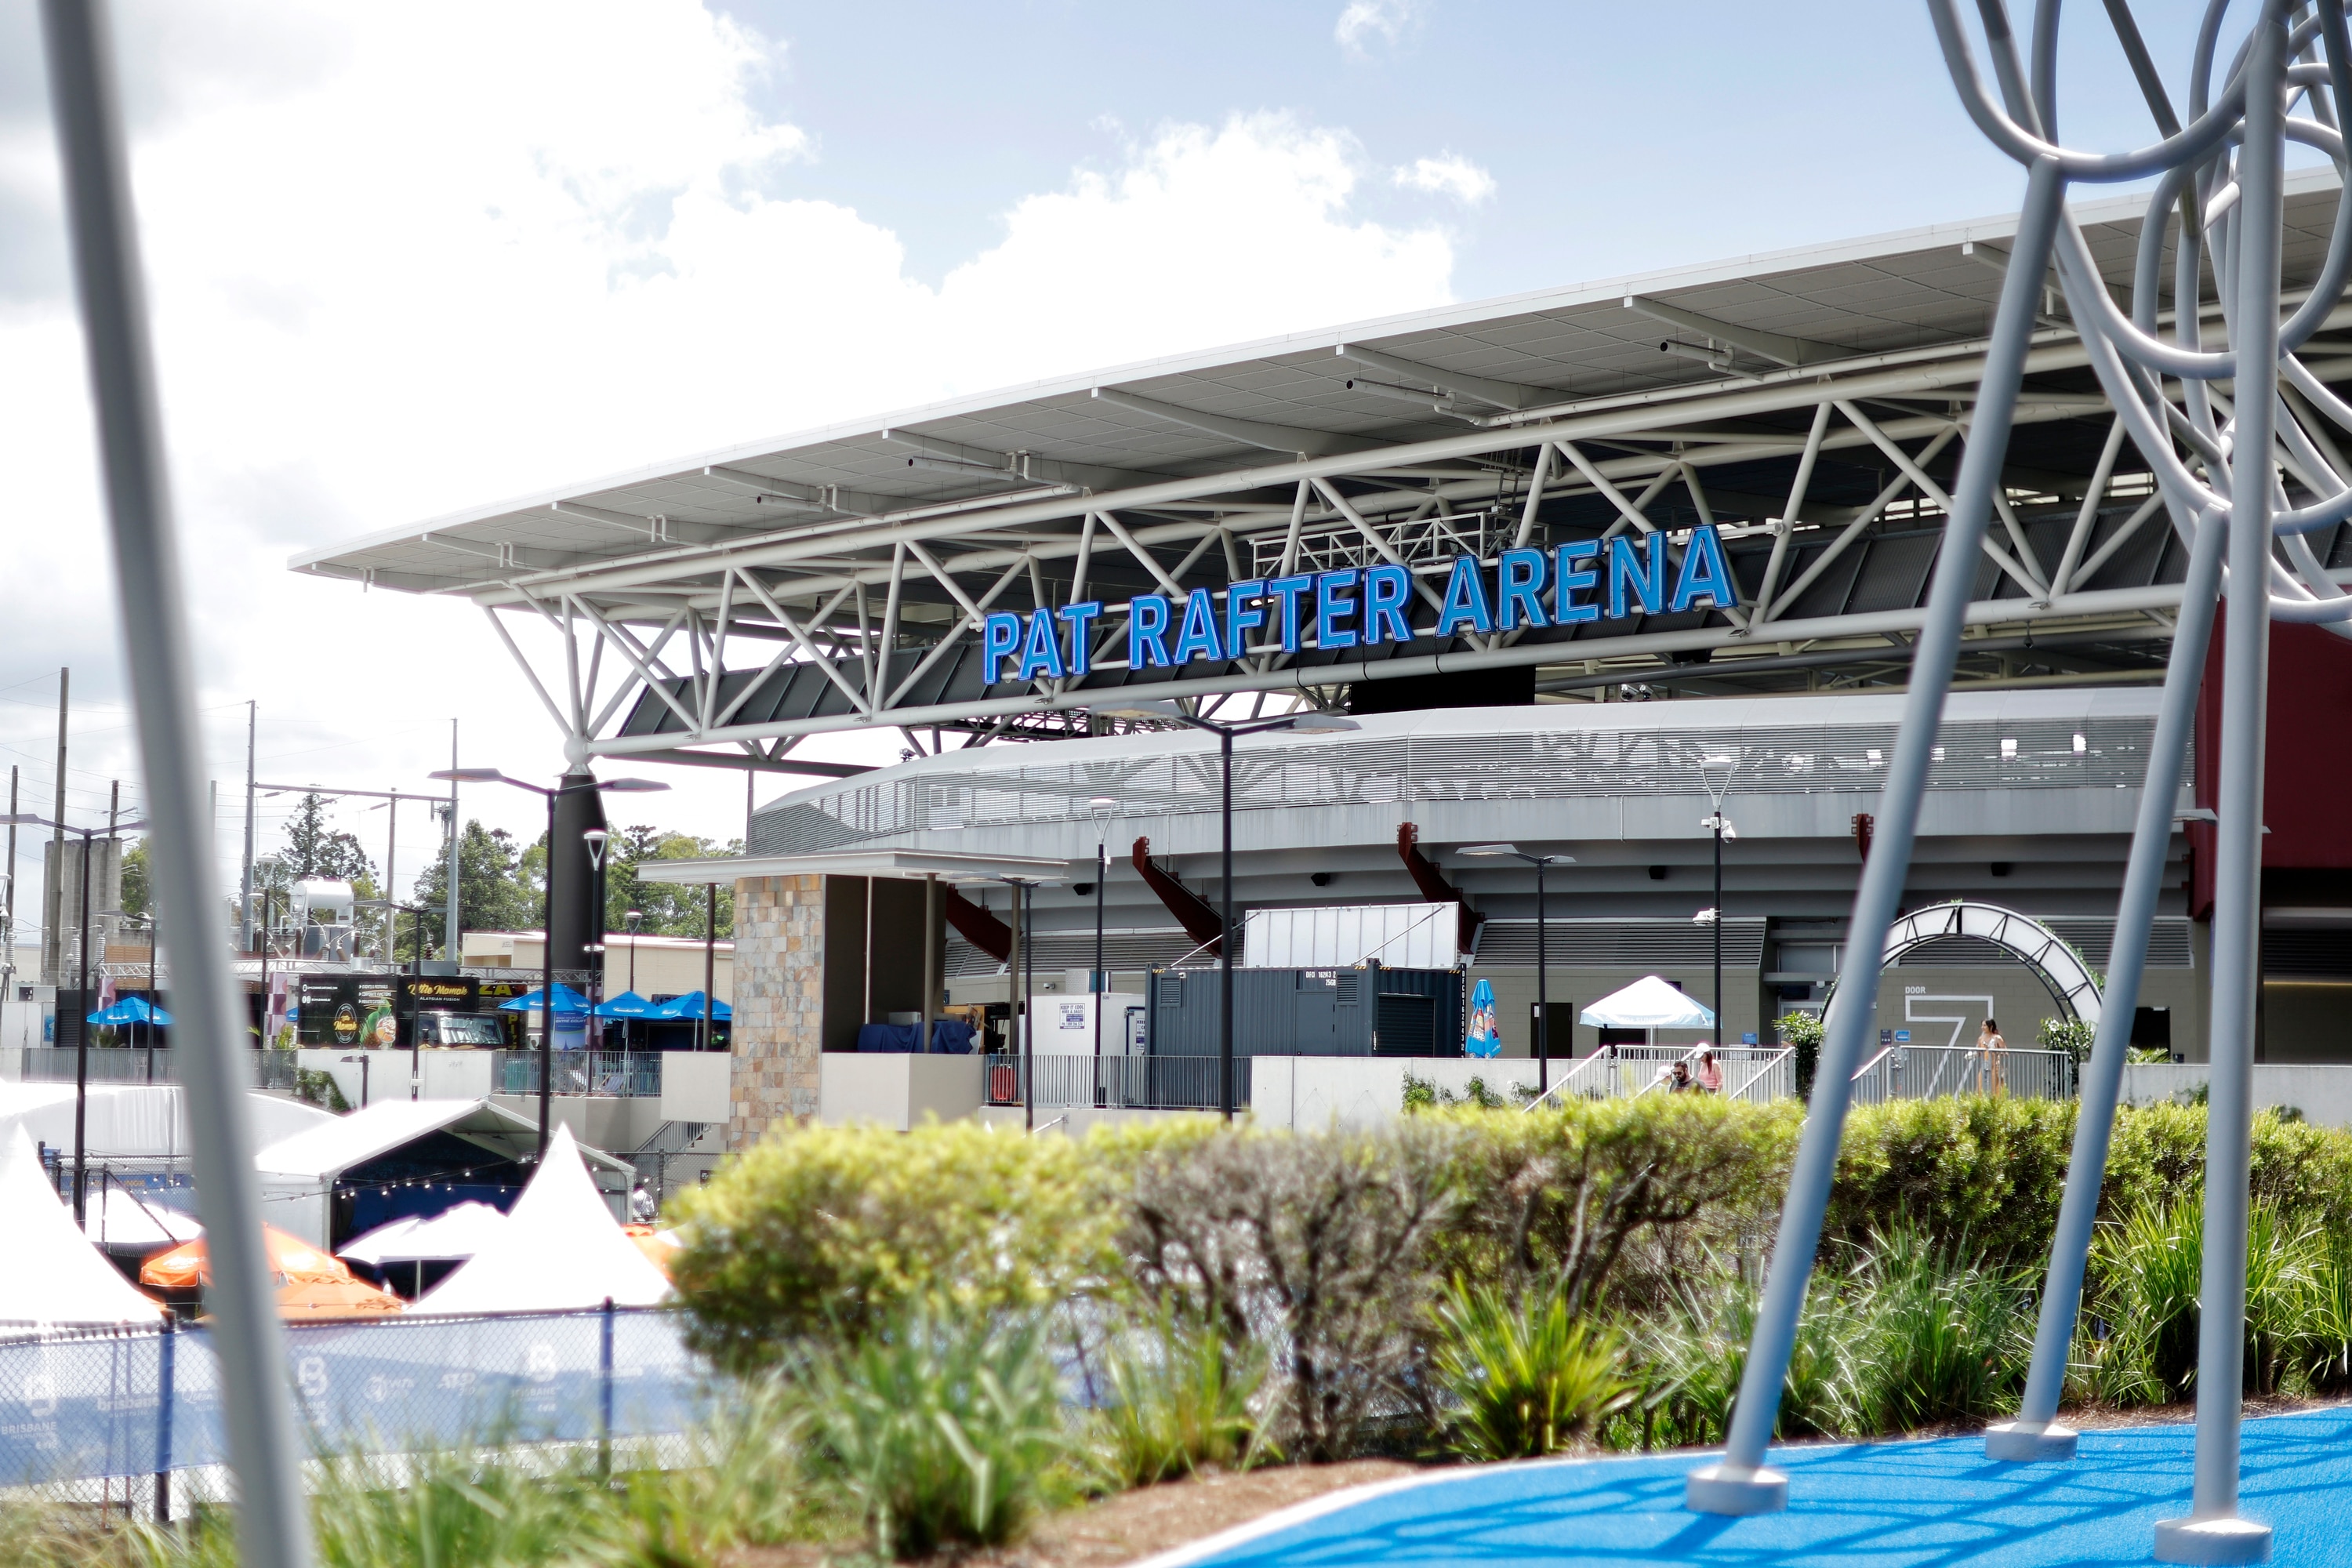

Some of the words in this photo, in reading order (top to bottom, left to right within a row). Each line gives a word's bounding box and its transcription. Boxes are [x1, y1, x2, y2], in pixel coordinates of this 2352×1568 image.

[983, 601, 1104, 684] PAT
[1128, 564, 1414, 670] RAFTER
[1436, 524, 1737, 638] ARENA
[97, 1394, 160, 1410] brisbane
[2, 1421, 57, 1435] BRISBANE
